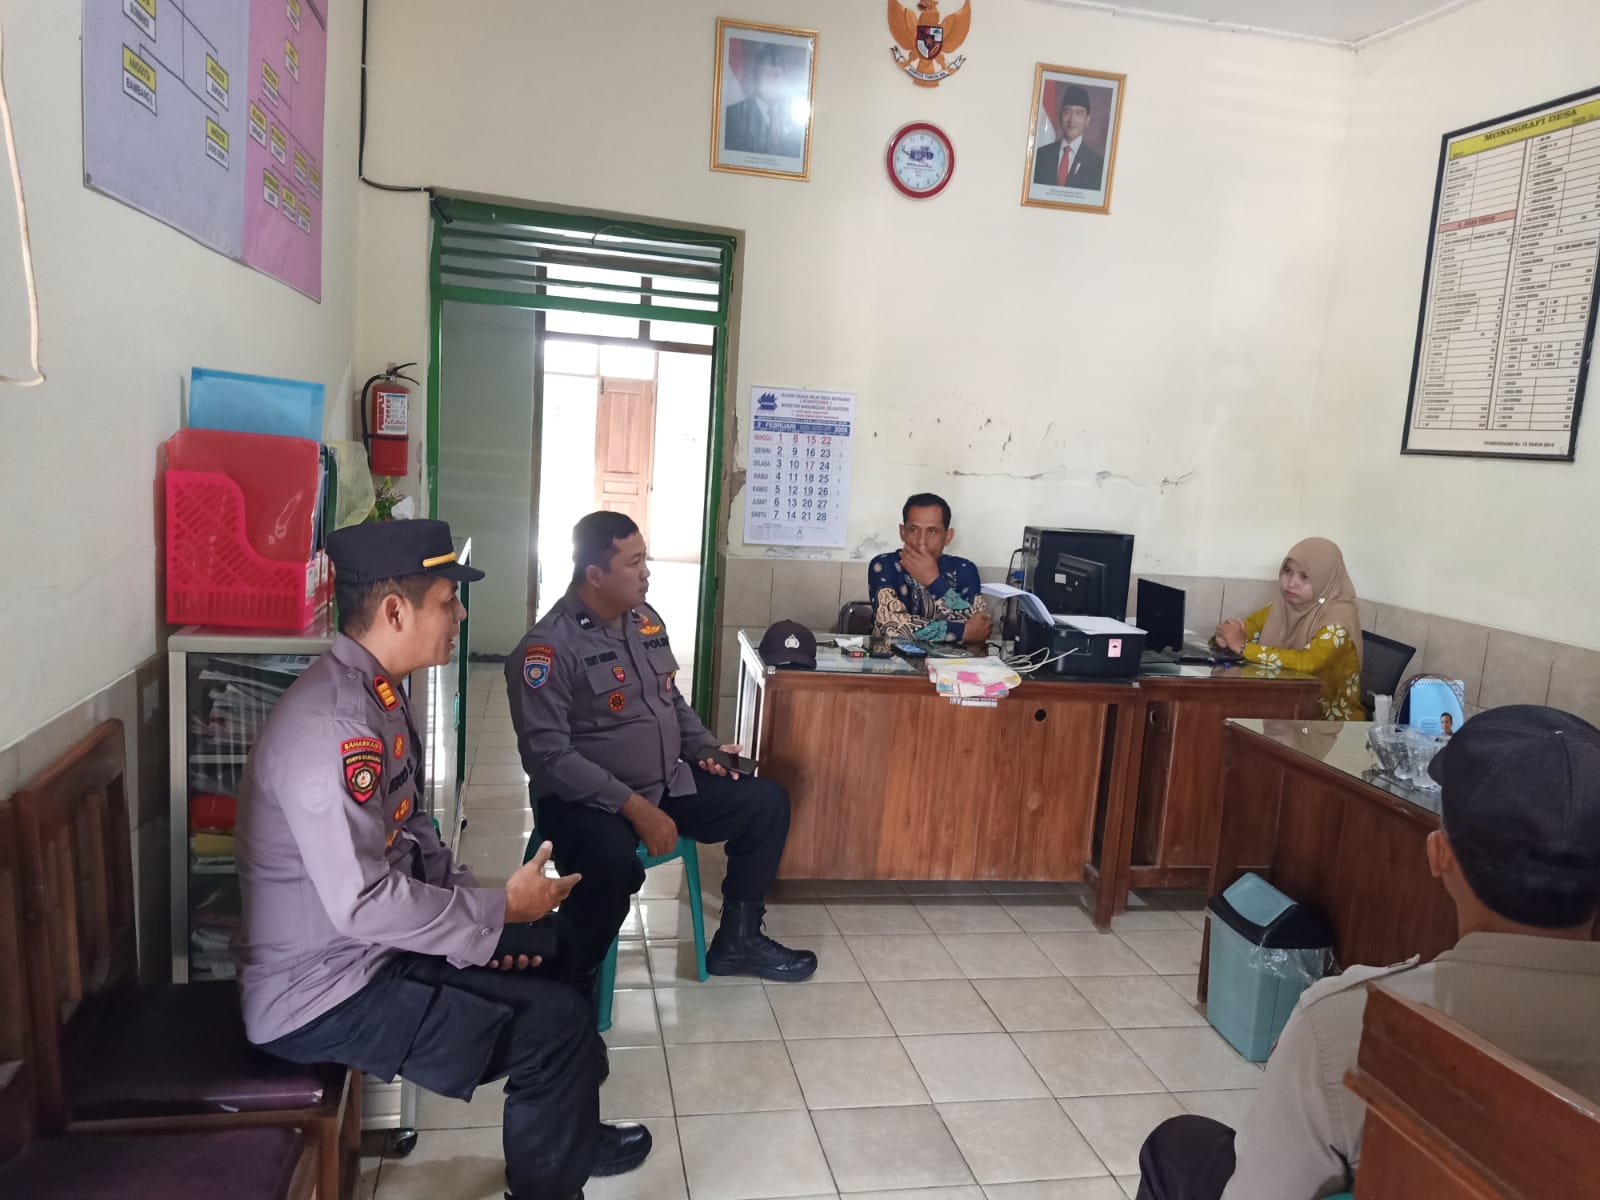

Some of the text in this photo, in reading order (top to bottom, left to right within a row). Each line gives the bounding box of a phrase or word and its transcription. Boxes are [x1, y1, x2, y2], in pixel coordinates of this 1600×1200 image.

[1484, 109, 1577, 141] MONOGRAFI DESA
[807, 435, 816, 444] 15
[821, 436, 831, 445] 22
[806, 448, 816, 457] 16
[820, 449, 831, 458] 23
[790, 460, 799, 469] 10
[805, 461, 815, 470] 17
[820, 462, 830, 470] 24
[789, 473, 798, 481] 11
[804, 474, 814, 483] 18
[819, 474, 829, 483] 25
[788, 486, 798, 494] 12
[803, 486, 813, 495] 19
[818, 487, 828, 496] 26
[787, 499, 797, 508] 13
[802, 499, 813, 508] 20
[817, 500, 827, 509] 27
[786, 511, 796, 520] 14
[801, 511, 811, 520] 21
[816, 512, 827, 521] 28
[643, 637, 669, 650] POLR
